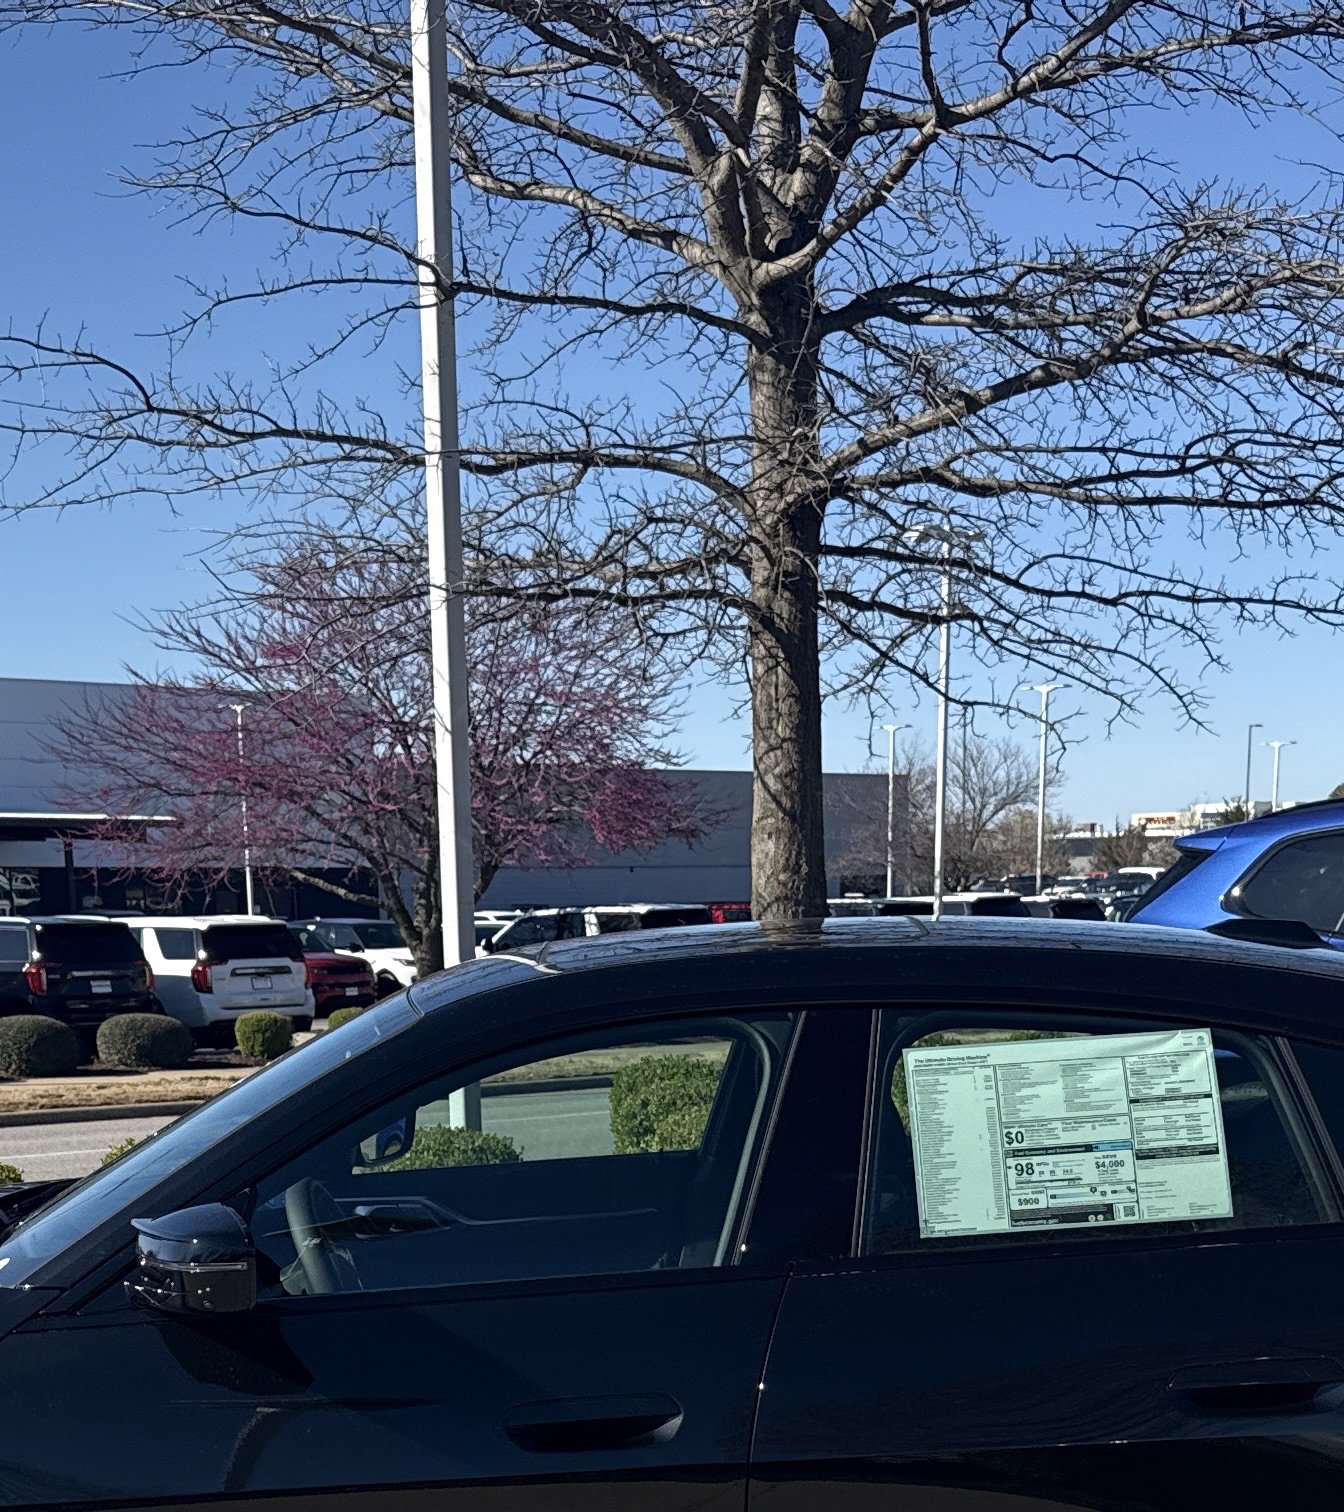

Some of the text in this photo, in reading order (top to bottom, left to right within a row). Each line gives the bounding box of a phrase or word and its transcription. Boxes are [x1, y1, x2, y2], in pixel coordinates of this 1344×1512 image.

[1004, 1130, 1024, 1146] $0
[1015, 1162, 1035, 1176] 98
[1095, 1159, 1125, 1170] $4,000
[1018, 1198, 1039, 1206] $900
